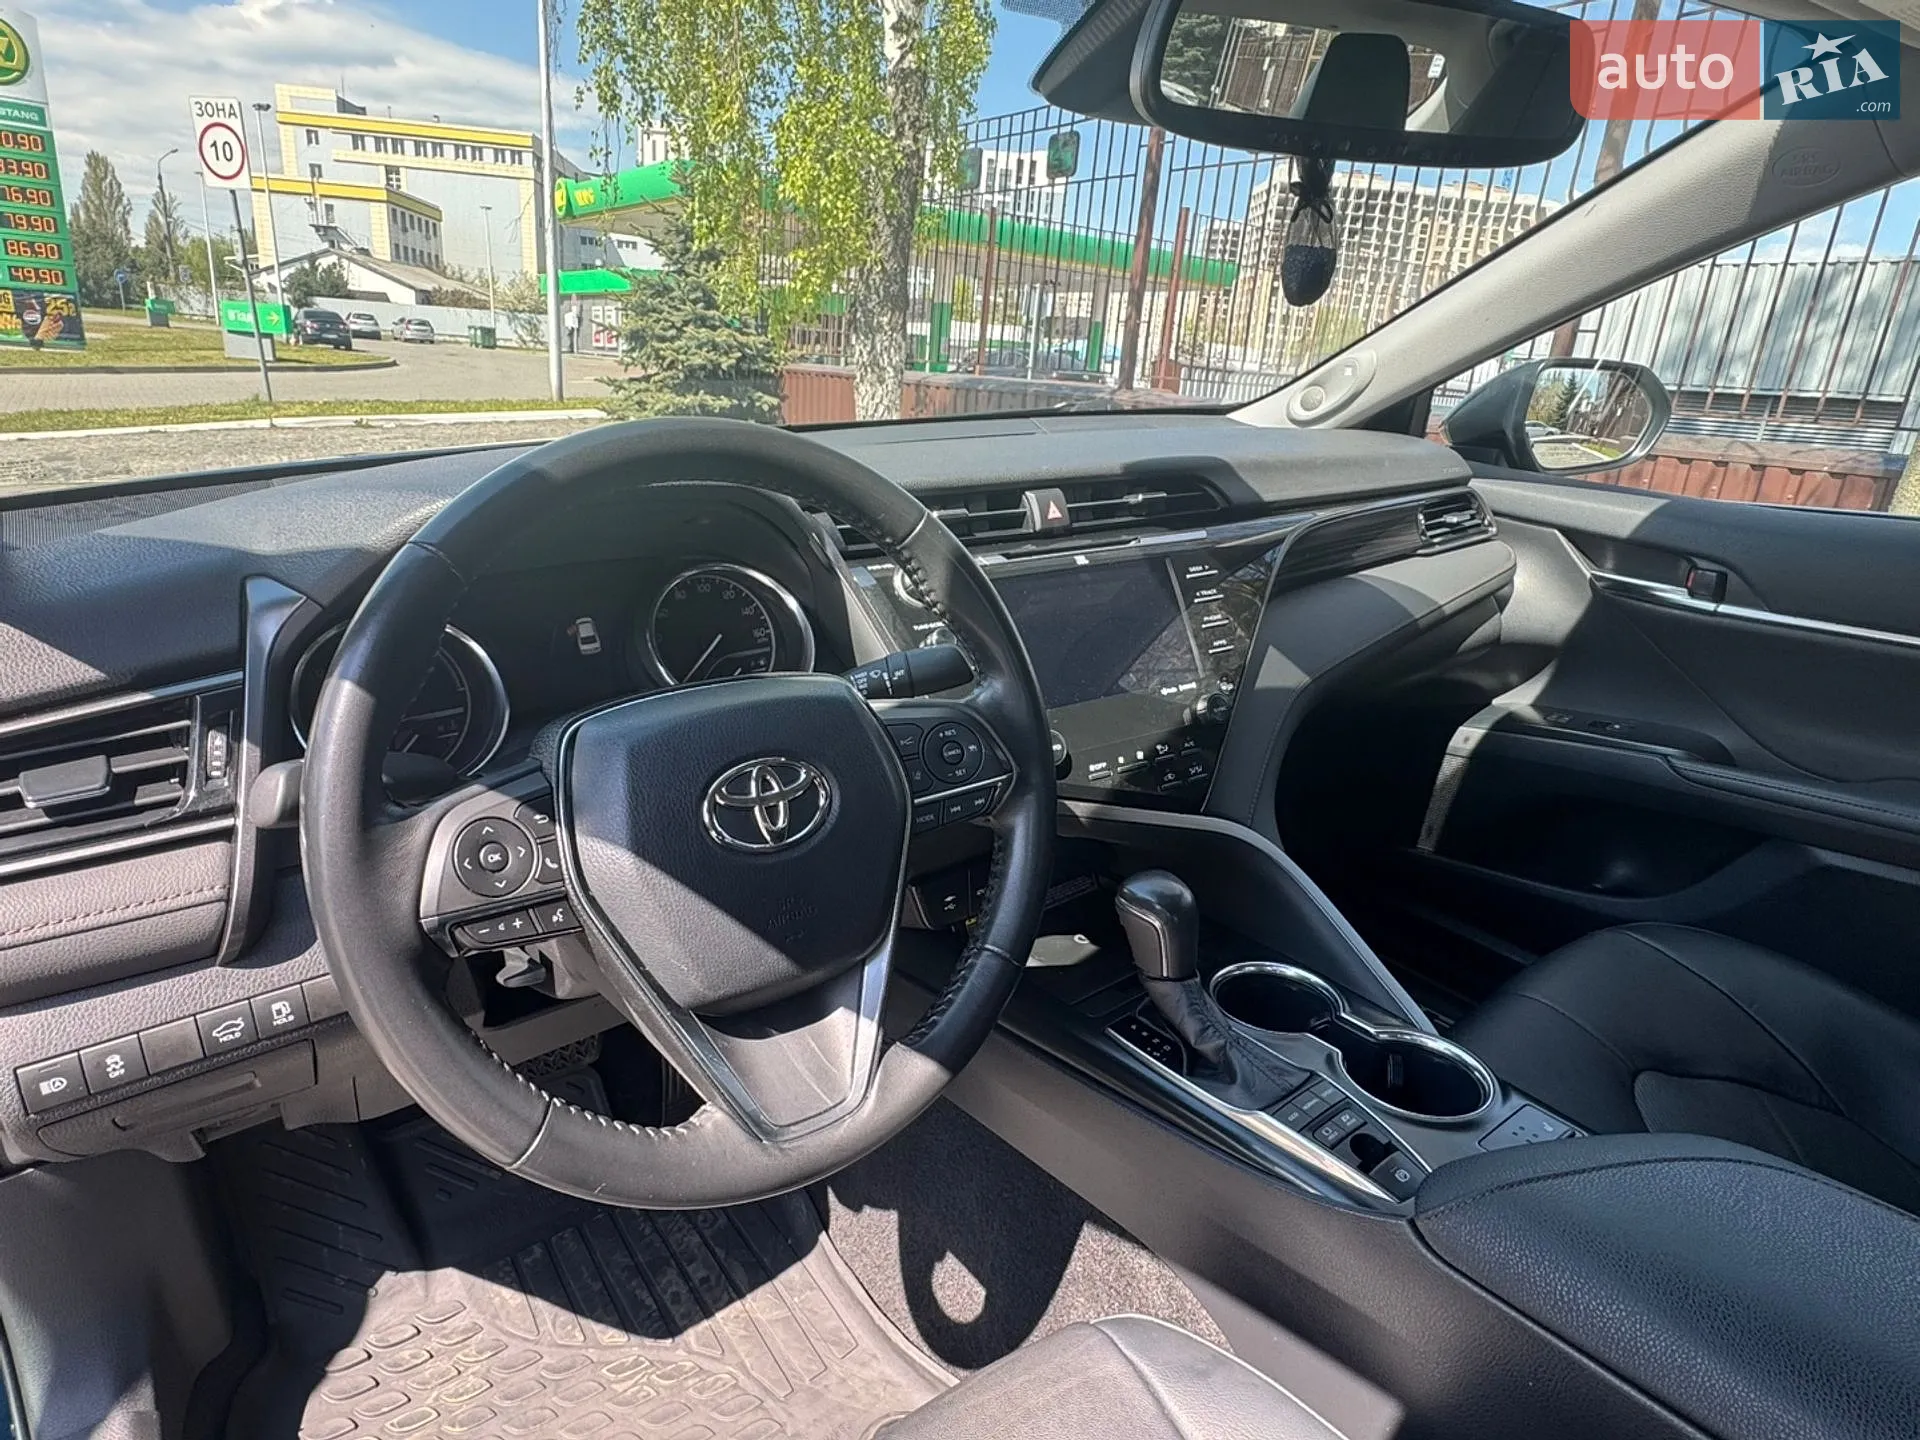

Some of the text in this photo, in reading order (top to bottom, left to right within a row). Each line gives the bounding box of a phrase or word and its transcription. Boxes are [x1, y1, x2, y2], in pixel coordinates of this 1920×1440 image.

[194, 101, 238, 119] ЗОНА
[210, 141, 233, 162] 10
[4, 213, 55, 233] 79.90
[7, 240, 59, 259] 86.90
[11, 267, 64, 285] 49.90
[487, 852, 502, 862] OK
[273, 1014, 295, 1027] HOLD
[218, 1031, 241, 1044] HOLD
[108, 1068, 125, 1079] OFF
